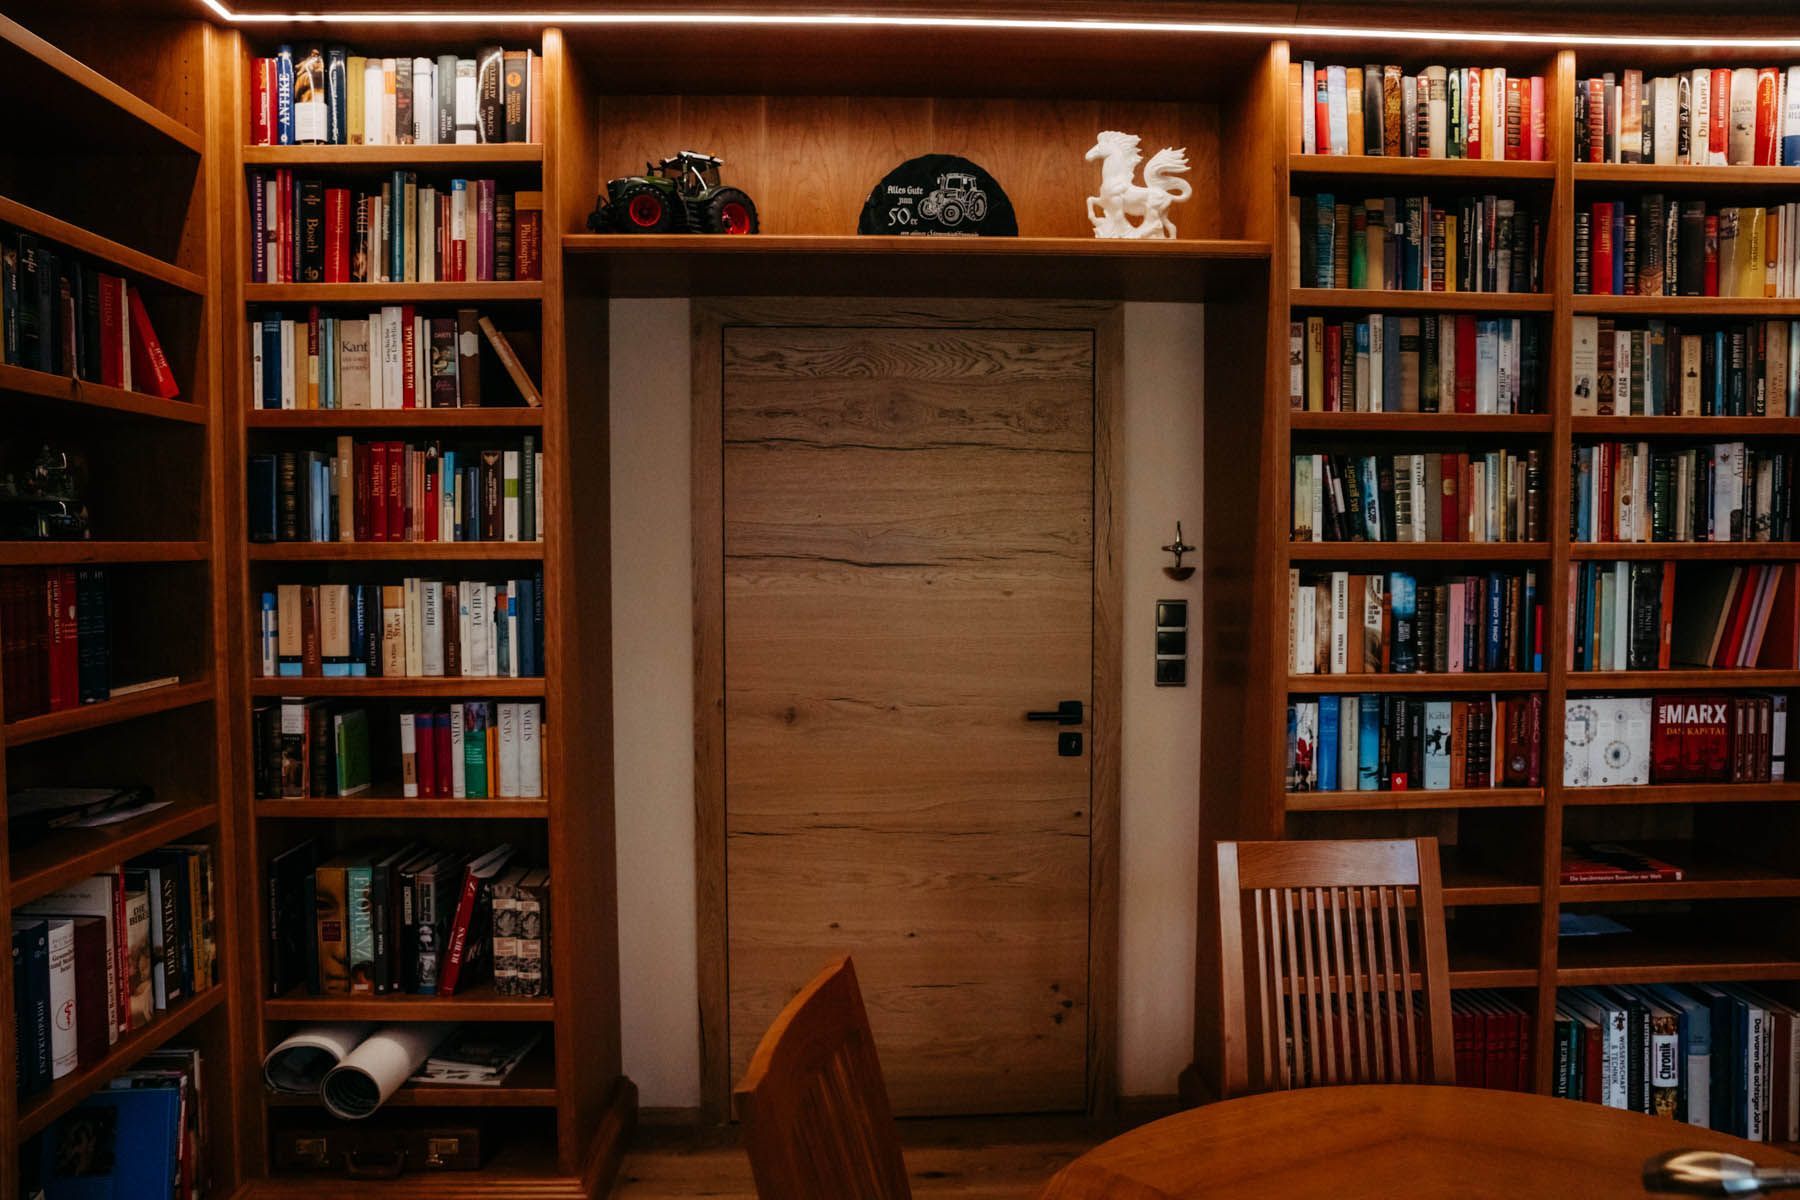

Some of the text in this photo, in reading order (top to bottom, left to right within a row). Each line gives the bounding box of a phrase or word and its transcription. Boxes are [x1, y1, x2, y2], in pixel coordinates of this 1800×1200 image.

[489, 62, 497, 99] ALTERTU
[279, 73, 290, 126] ANTIKE
[487, 105, 495, 136] SCHWAB
[887, 185, 924, 195] Alles Gute
[356, 198, 368, 234] EDDA
[888, 207, 911, 227] 50
[304, 216, 320, 253] Bosch
[518, 223, 532, 274] Philosophie
[342, 341, 369, 353] Kant
[390, 321, 398, 353] Überblick
[1732, 333, 1744, 369] BABYLON
[404, 325, 414, 390] DIE EREMITAGE
[371, 460, 381, 497] Denken.
[389, 460, 398, 497] Denken.
[393, 612, 401, 637] STAAT
[426, 587, 435, 626] HERODOT
[473, 588, 482, 627] TACITUS
[369, 632, 377, 667] PLUTARCH
[452, 710, 460, 744] SALLUST
[503, 708, 512, 743] CAESAR
[1658, 704, 1668, 724] KARL
[1667, 704, 1728, 724] MARX
[1667, 727, 1728, 736] DAS KAPITAL
[133, 904, 146, 916] DIE
[163, 880, 176, 976] DER VATIKAN
[353, 875, 371, 959] FLORENZ
[451, 927, 467, 965] RUBENS
[1558, 1039, 1568, 1095] HABSBURGER
[1618, 1035, 1626, 1095] WISSENSCHAFT
[1659, 1042, 1671, 1080] Chronik
[1752, 1075, 1760, 1111] achtziger
[1752, 1111, 1760, 1134] Jahre
